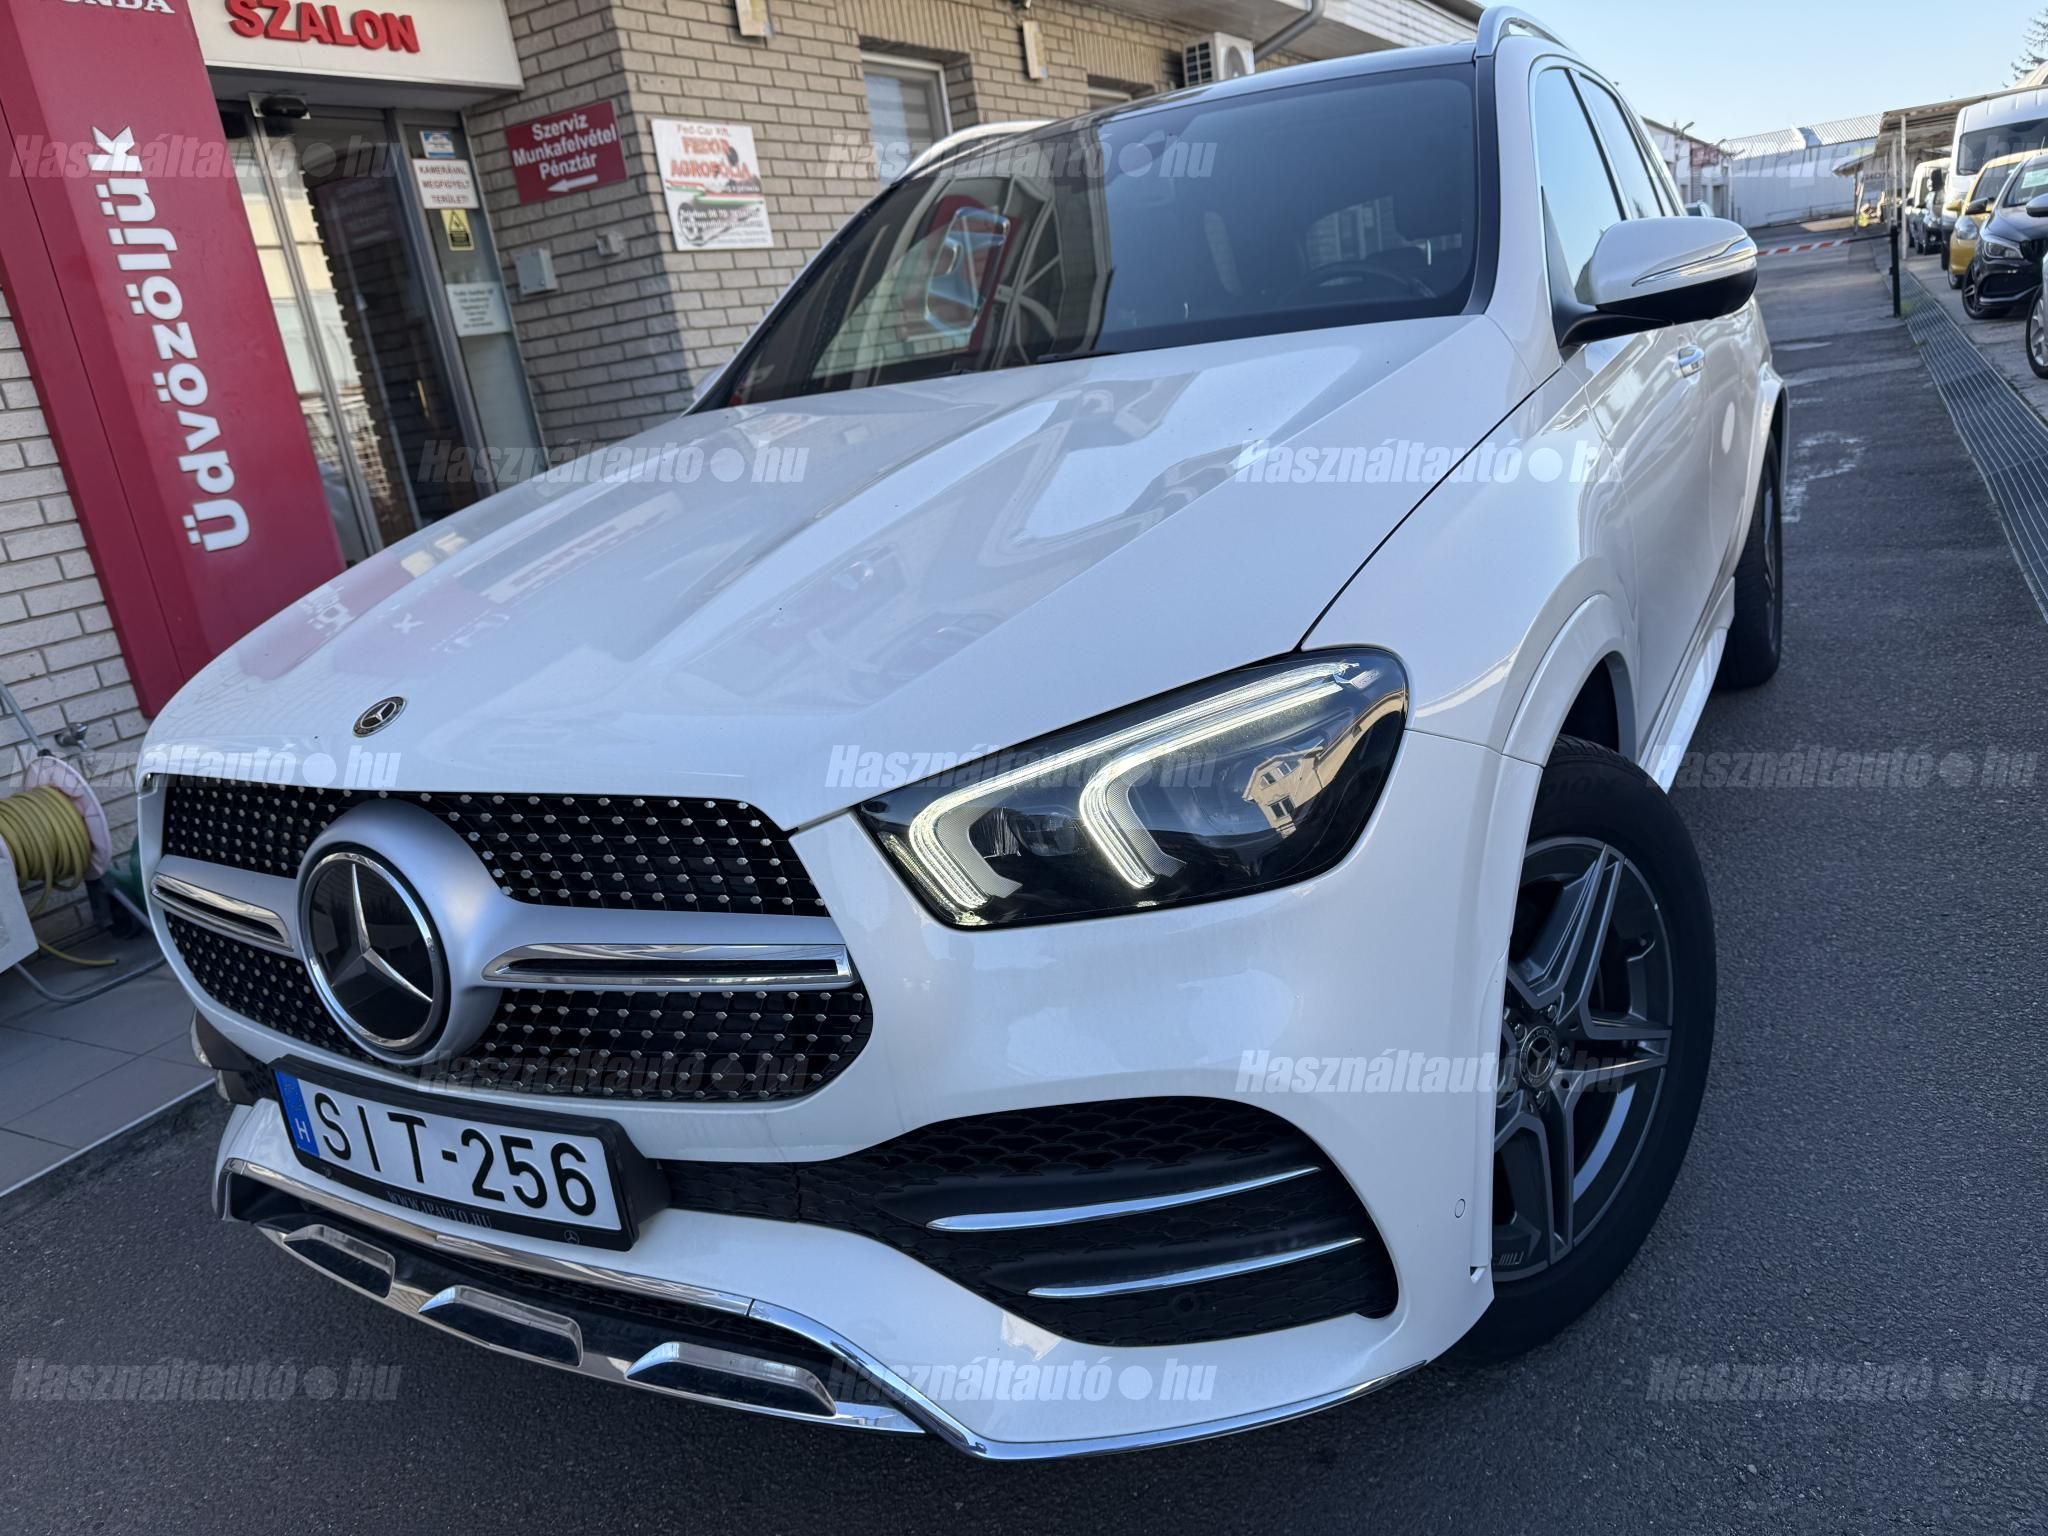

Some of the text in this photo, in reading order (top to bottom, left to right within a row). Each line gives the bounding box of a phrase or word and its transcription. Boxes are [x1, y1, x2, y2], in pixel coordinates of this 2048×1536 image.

[226, 0, 420, 53] SZALON
[511, 123, 617, 167] Munkafelvétel
[531, 113, 589, 141] Szerviz
[538, 151, 598, 180] Pénztár
[87, 125, 251, 552] Üdvözöljük
[295, 1118, 311, 1143] H
[314, 1092, 597, 1216] SIT-256
